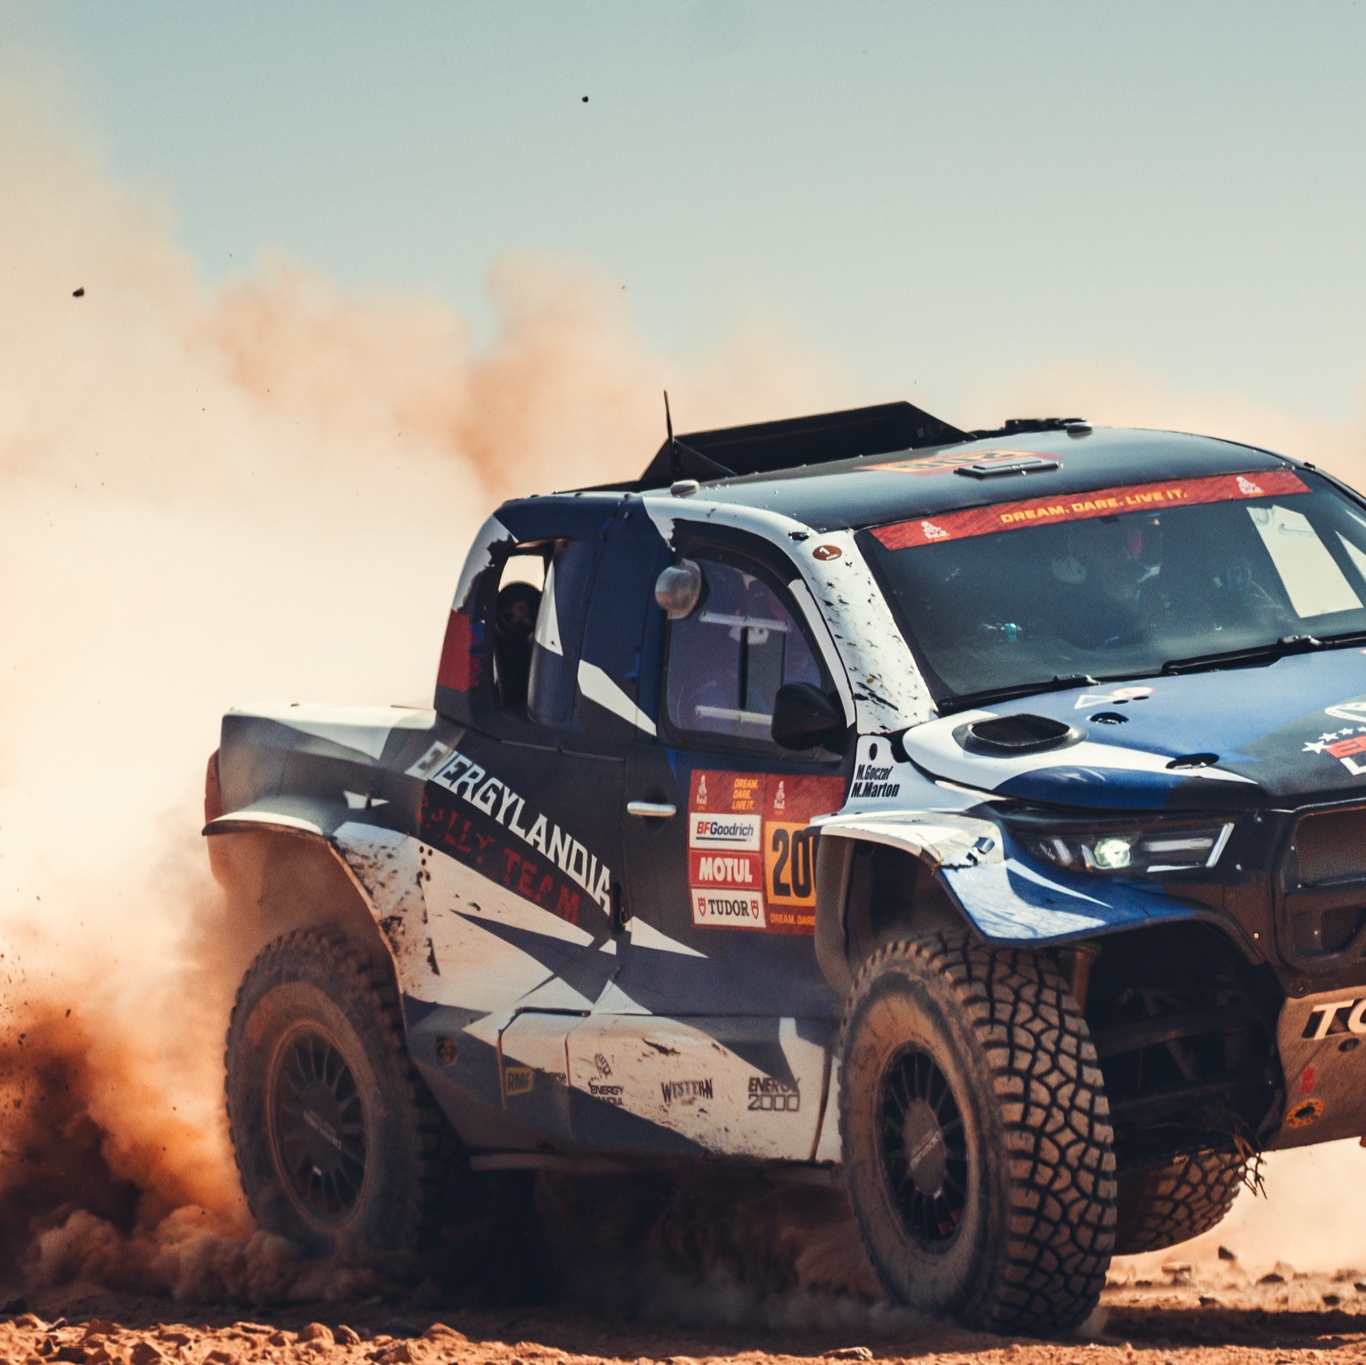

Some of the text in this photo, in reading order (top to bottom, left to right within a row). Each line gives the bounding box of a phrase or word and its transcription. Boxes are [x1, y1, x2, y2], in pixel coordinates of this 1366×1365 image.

[1000, 487, 1188, 523] DREAM. DARE. LIVE IT.
[850, 781, 901, 798] M.Marton
[404, 740, 612, 917] EERGYLANDIA
[696, 821, 754, 837] BFGoodrich
[698, 857, 753, 883] MOTUL
[771, 828, 816, 899] 20
[708, 899, 750, 917] TUDOR
[591, 1085, 624, 1097] ENERGY
[660, 1078, 714, 1104] WESTERN
[747, 1093, 801, 1112] 2000
